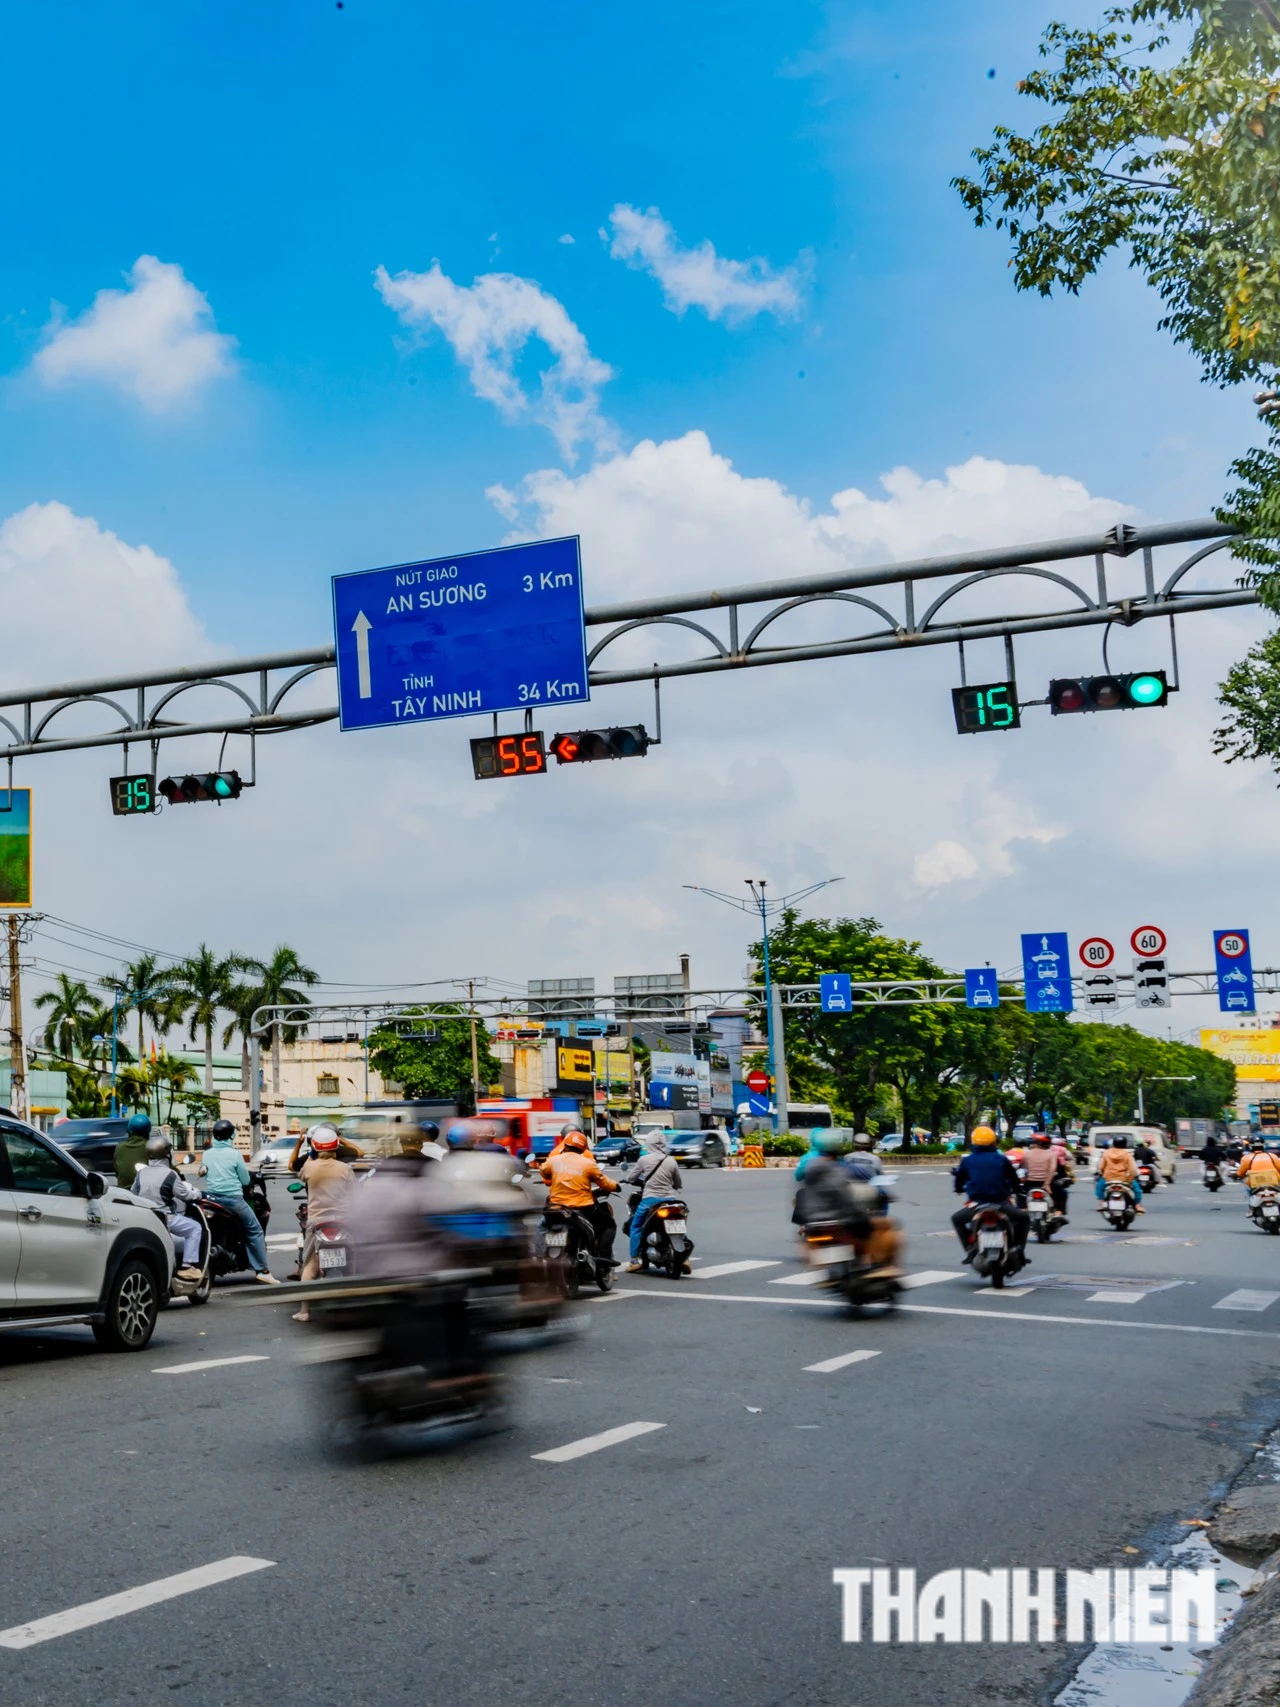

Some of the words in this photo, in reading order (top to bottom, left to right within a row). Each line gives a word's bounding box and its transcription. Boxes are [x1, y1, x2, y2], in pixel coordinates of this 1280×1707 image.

[396, 568, 423, 587] NÚT
[426, 566, 458, 582] GIAO
[386, 594, 412, 614] AN
[419, 582, 487, 609] SƯƠNG
[523, 575, 533, 592] 3
[540, 572, 573, 590] Km
[402, 673, 434, 691] TỈNH
[392, 698, 427, 718] TÂY
[433, 690, 481, 712] NINH
[518, 684, 540, 702] 34
[546, 680, 579, 698] Km
[976, 686, 1013, 726] 15
[499, 738, 542, 774] 55
[127, 778, 150, 810] 15
[1089, 947, 1104, 960] 80
[1142, 935, 1156, 948] 60
[1225, 940, 1238, 950] 50
